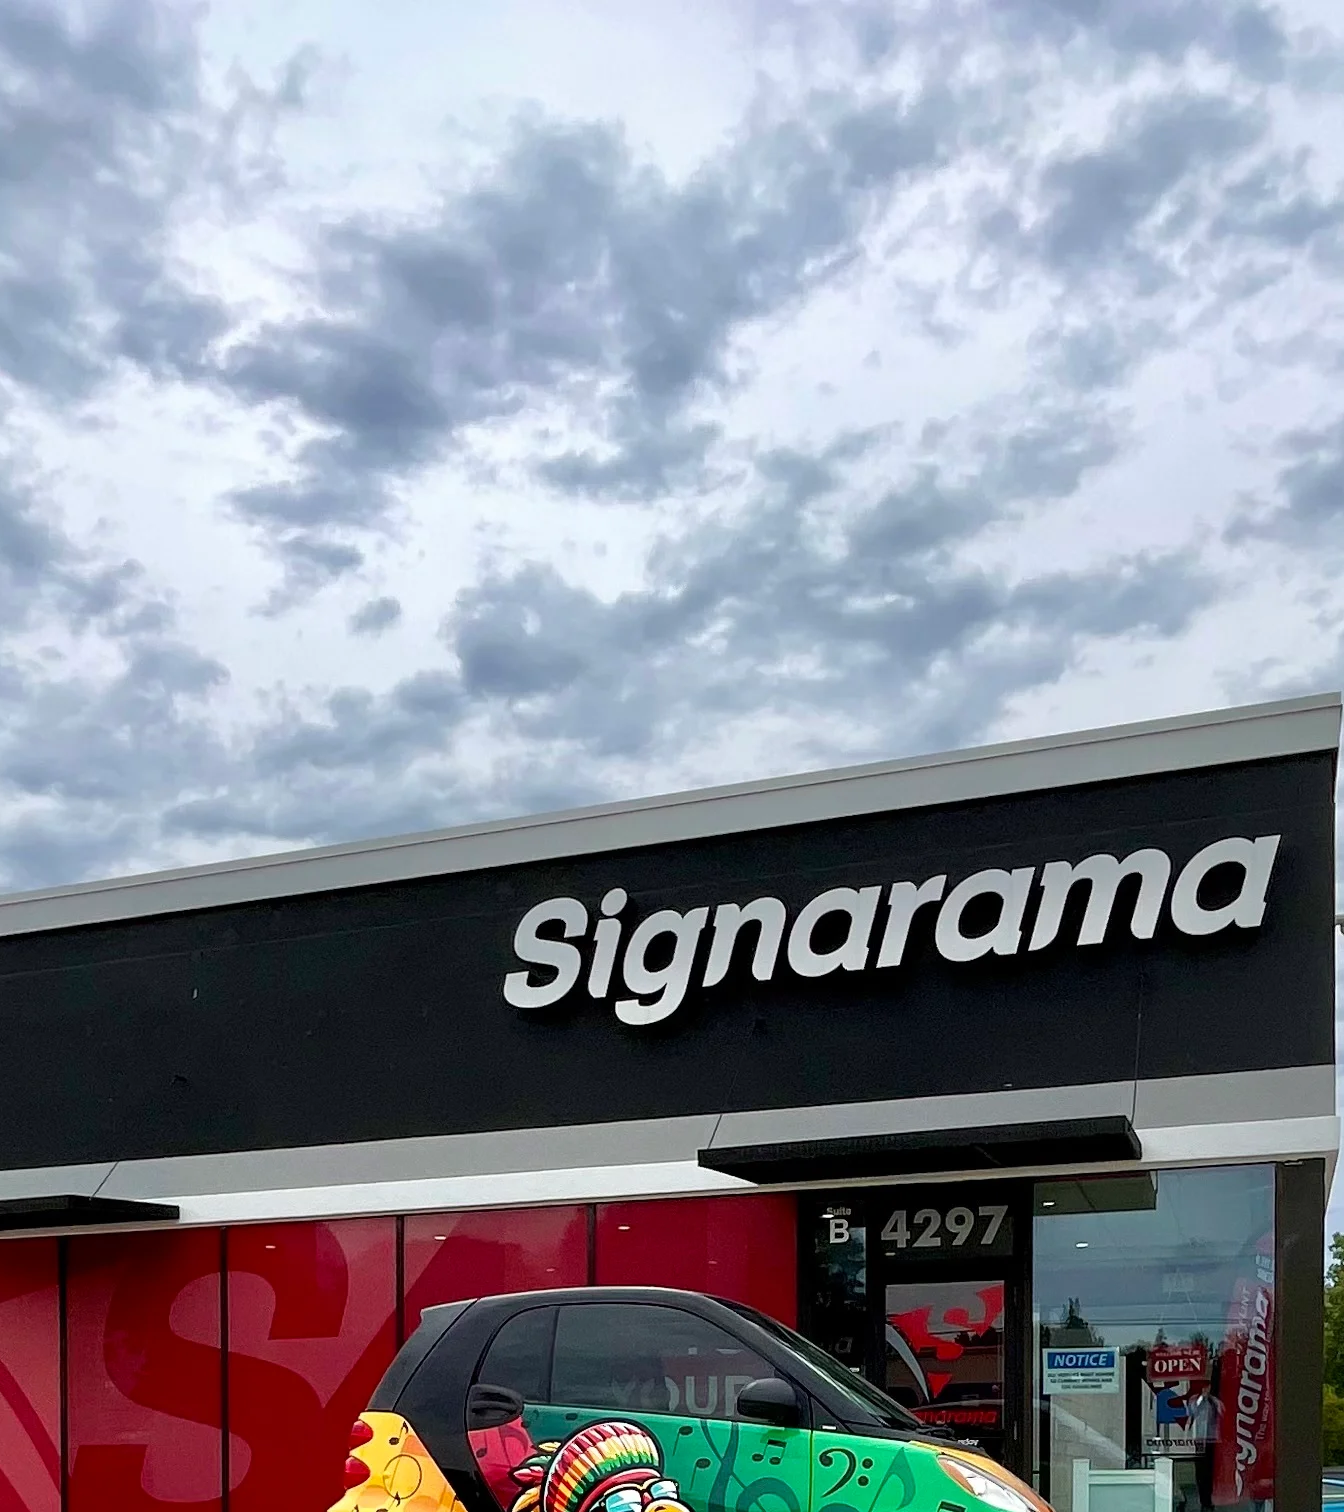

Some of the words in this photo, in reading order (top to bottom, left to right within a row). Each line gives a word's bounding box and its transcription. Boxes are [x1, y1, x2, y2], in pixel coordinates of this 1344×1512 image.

[503, 833, 1282, 1026] Signarama
[826, 1206, 852, 1216] Suite
[829, 1218, 850, 1244] B
[881, 1205, 1009, 1249] 4297
[1054, 1353, 1108, 1367] NOTICE
[1154, 1357, 1202, 1373] OPEN
